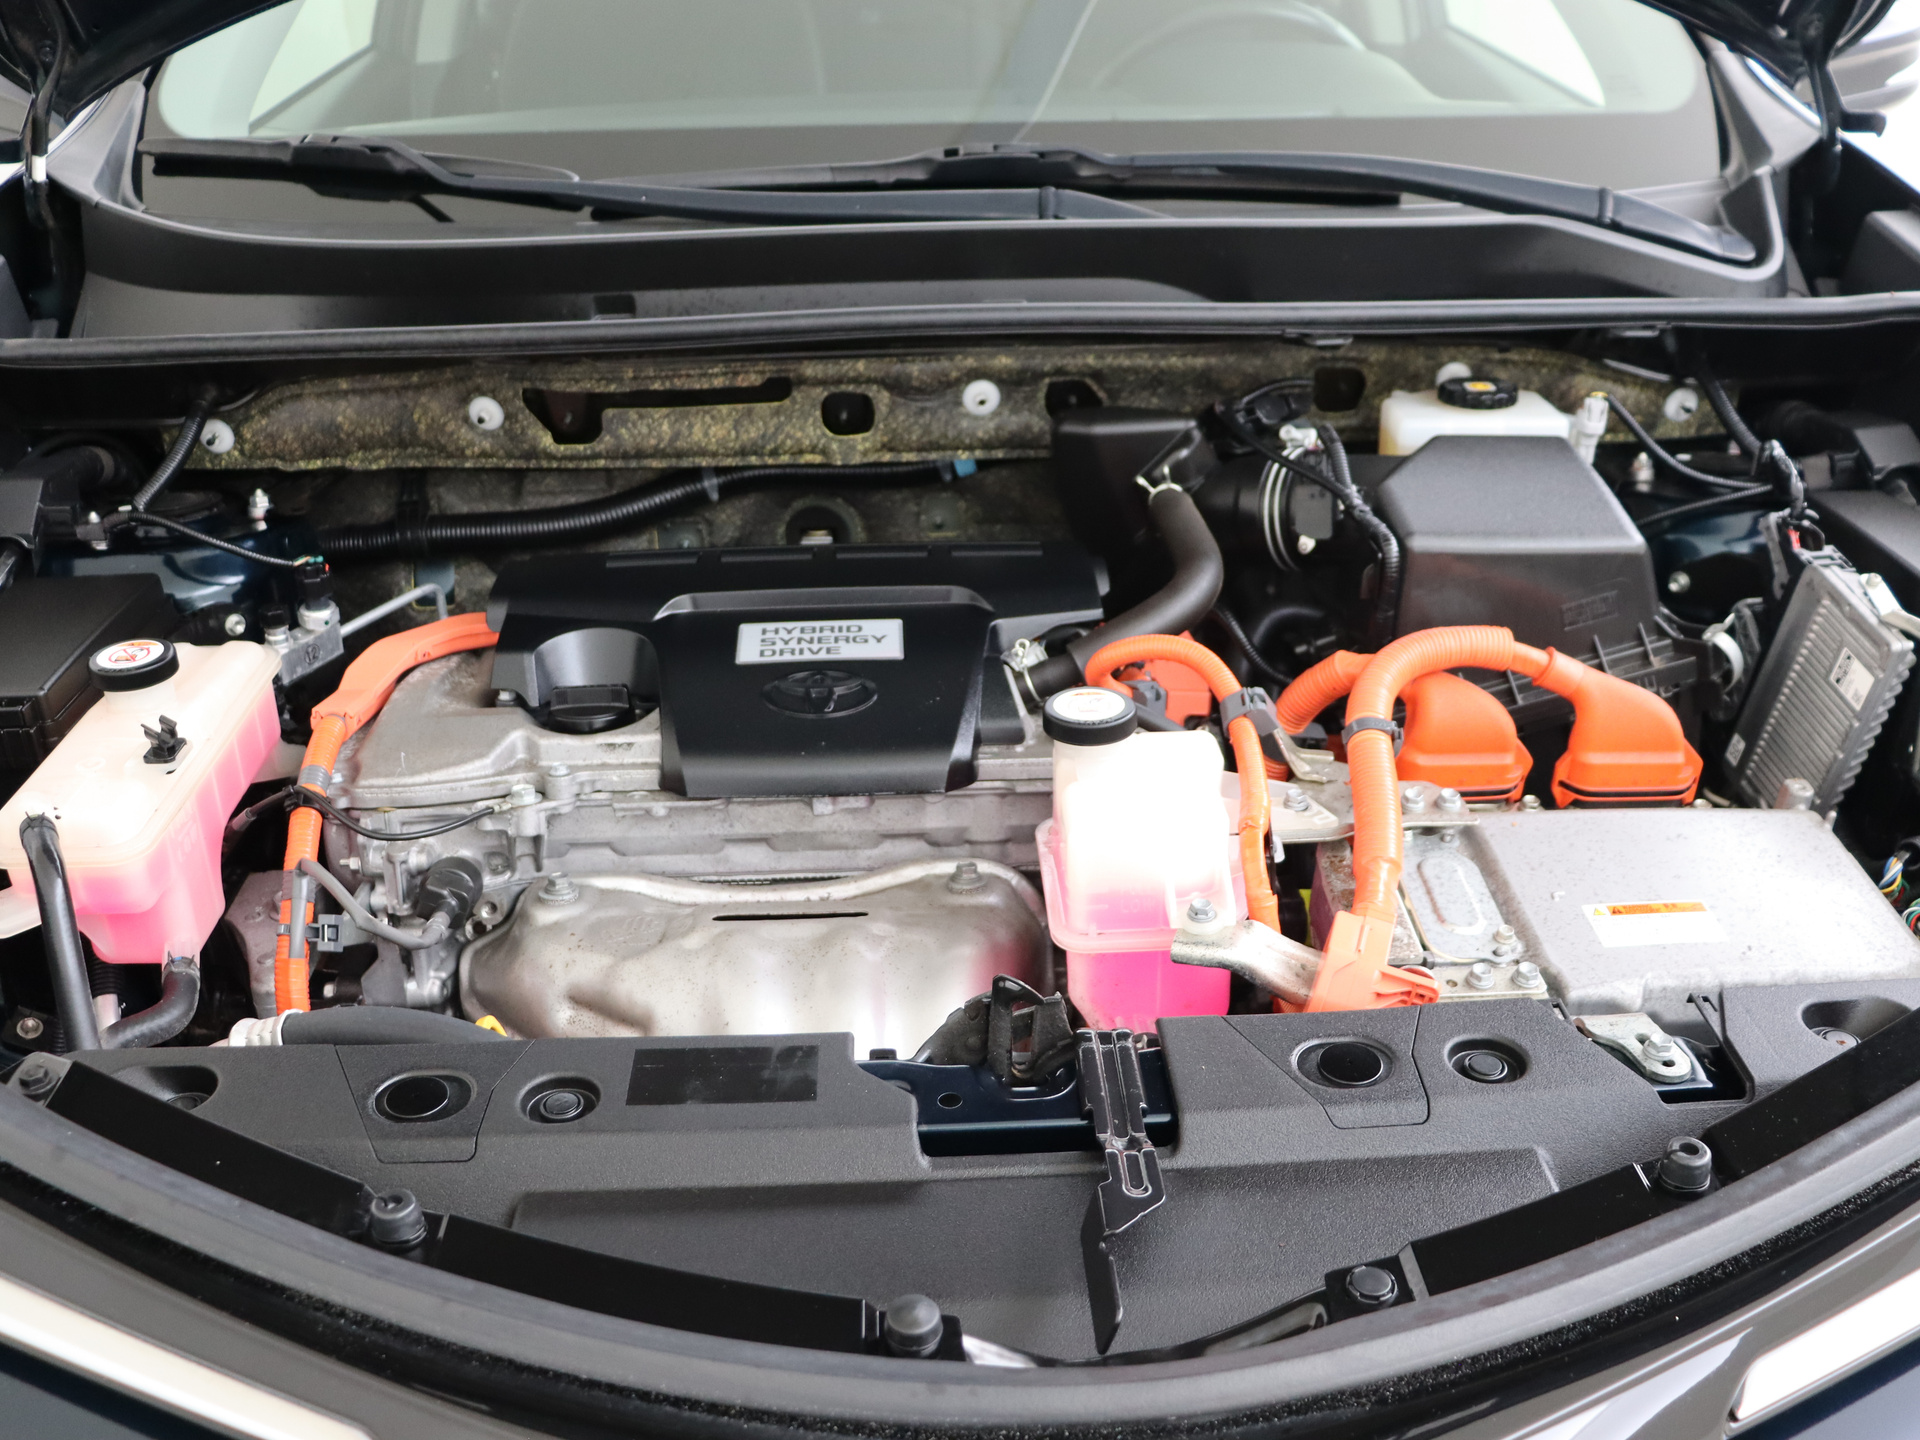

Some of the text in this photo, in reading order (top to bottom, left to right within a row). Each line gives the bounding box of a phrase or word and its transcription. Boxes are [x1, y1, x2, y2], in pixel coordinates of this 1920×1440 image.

[761, 625, 863, 635] HYBRID
[760, 635, 887, 646] SYNERGY
[760, 646, 841, 657] DRIVE
